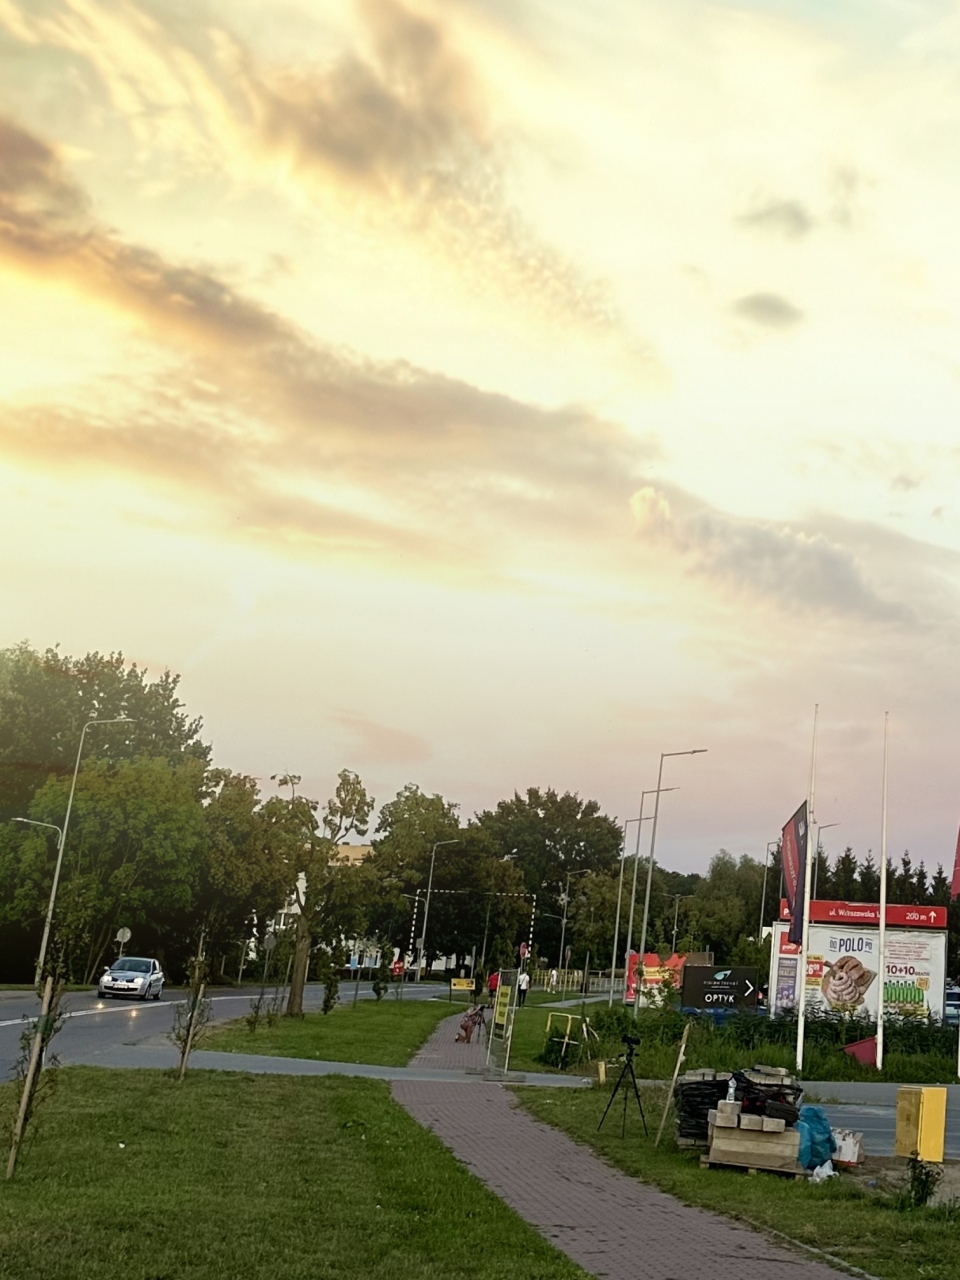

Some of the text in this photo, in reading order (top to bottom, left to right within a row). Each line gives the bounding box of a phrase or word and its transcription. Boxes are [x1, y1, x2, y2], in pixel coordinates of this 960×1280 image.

[905, 912, 919, 921] 200
[838, 937, 864, 952] POLO
[885, 965, 915, 976] 10+10
[704, 993, 735, 1003] OPTYK
